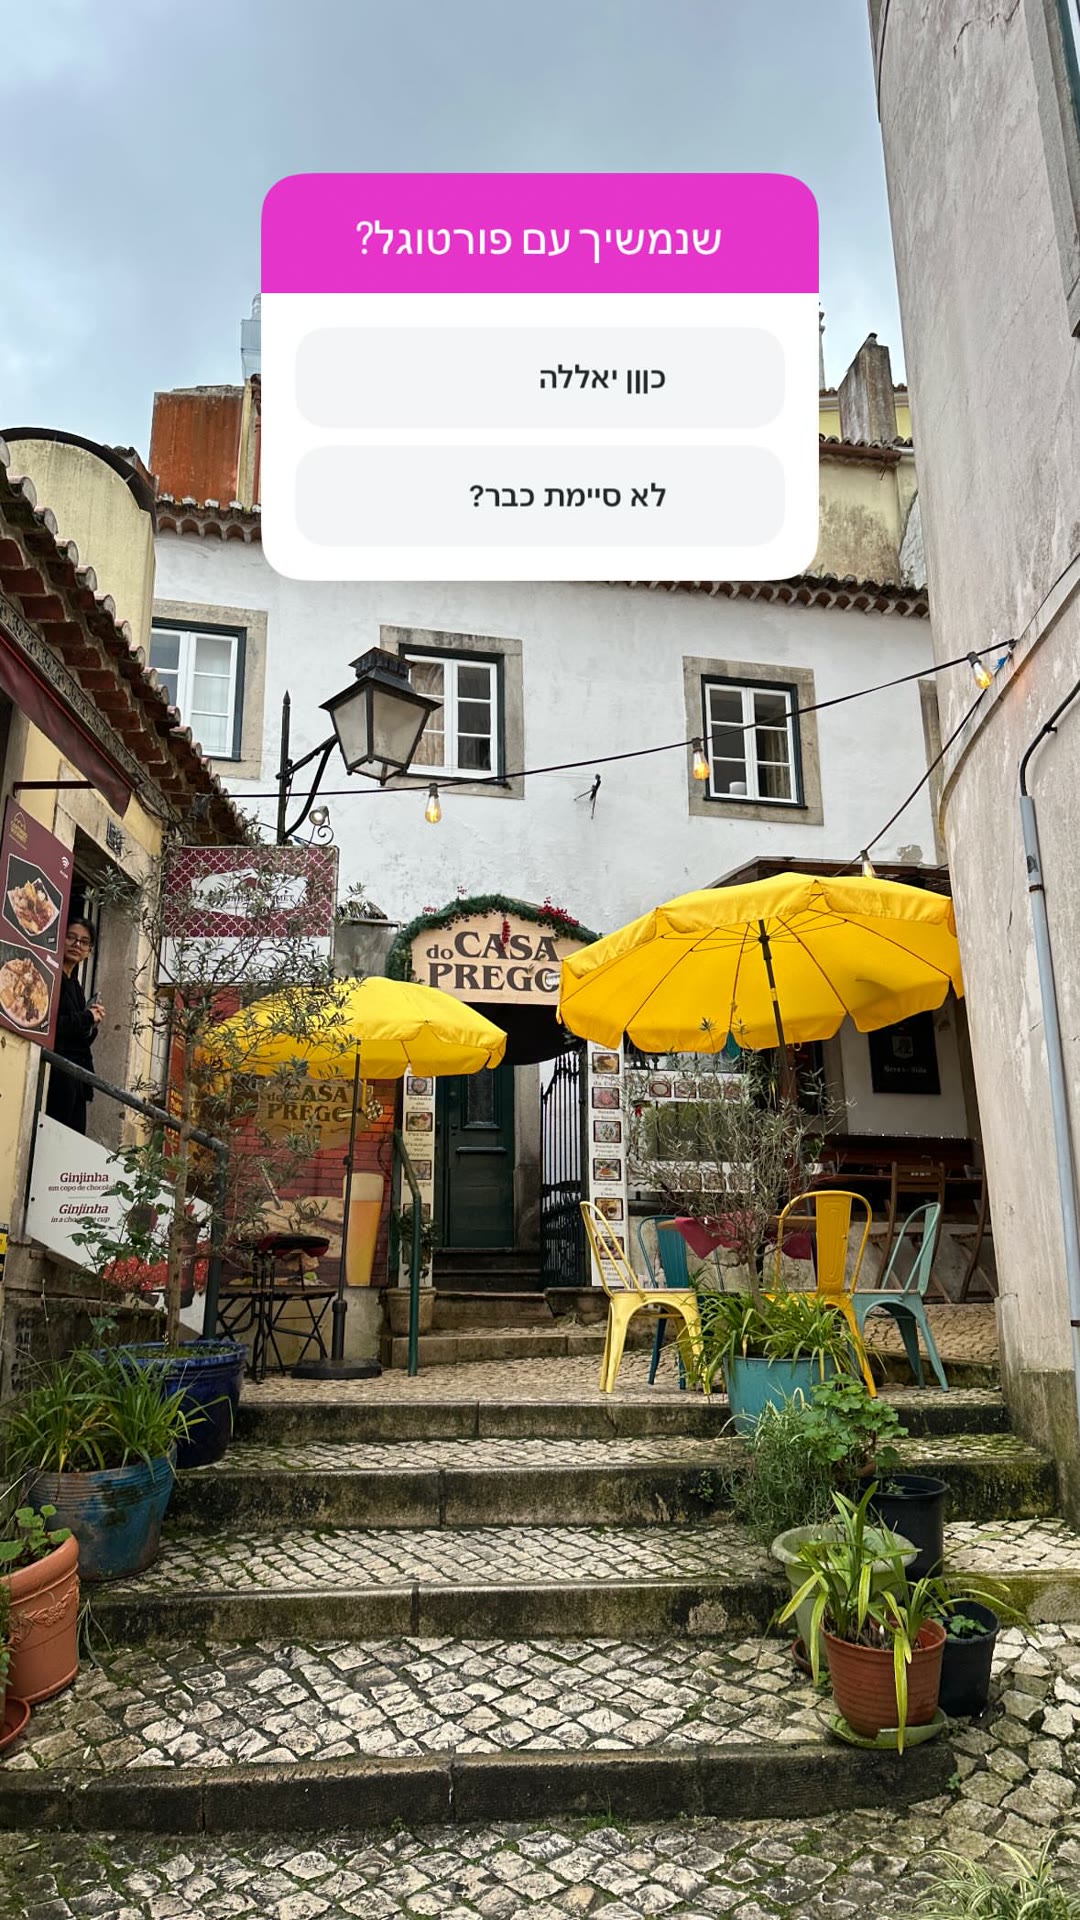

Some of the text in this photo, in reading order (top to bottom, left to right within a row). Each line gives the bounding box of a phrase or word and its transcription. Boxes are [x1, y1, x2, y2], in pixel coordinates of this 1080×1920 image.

[426, 931, 561, 962] do CASA
[428, 962, 560, 993] PREGO
[60, 1172, 109, 1184] Ginjinha
[60, 1185, 77, 1193] copo
[77, 1184, 86, 1192] de
[86, 1184, 116, 1192] chocola
[59, 1203, 109, 1216] Ginjinha
